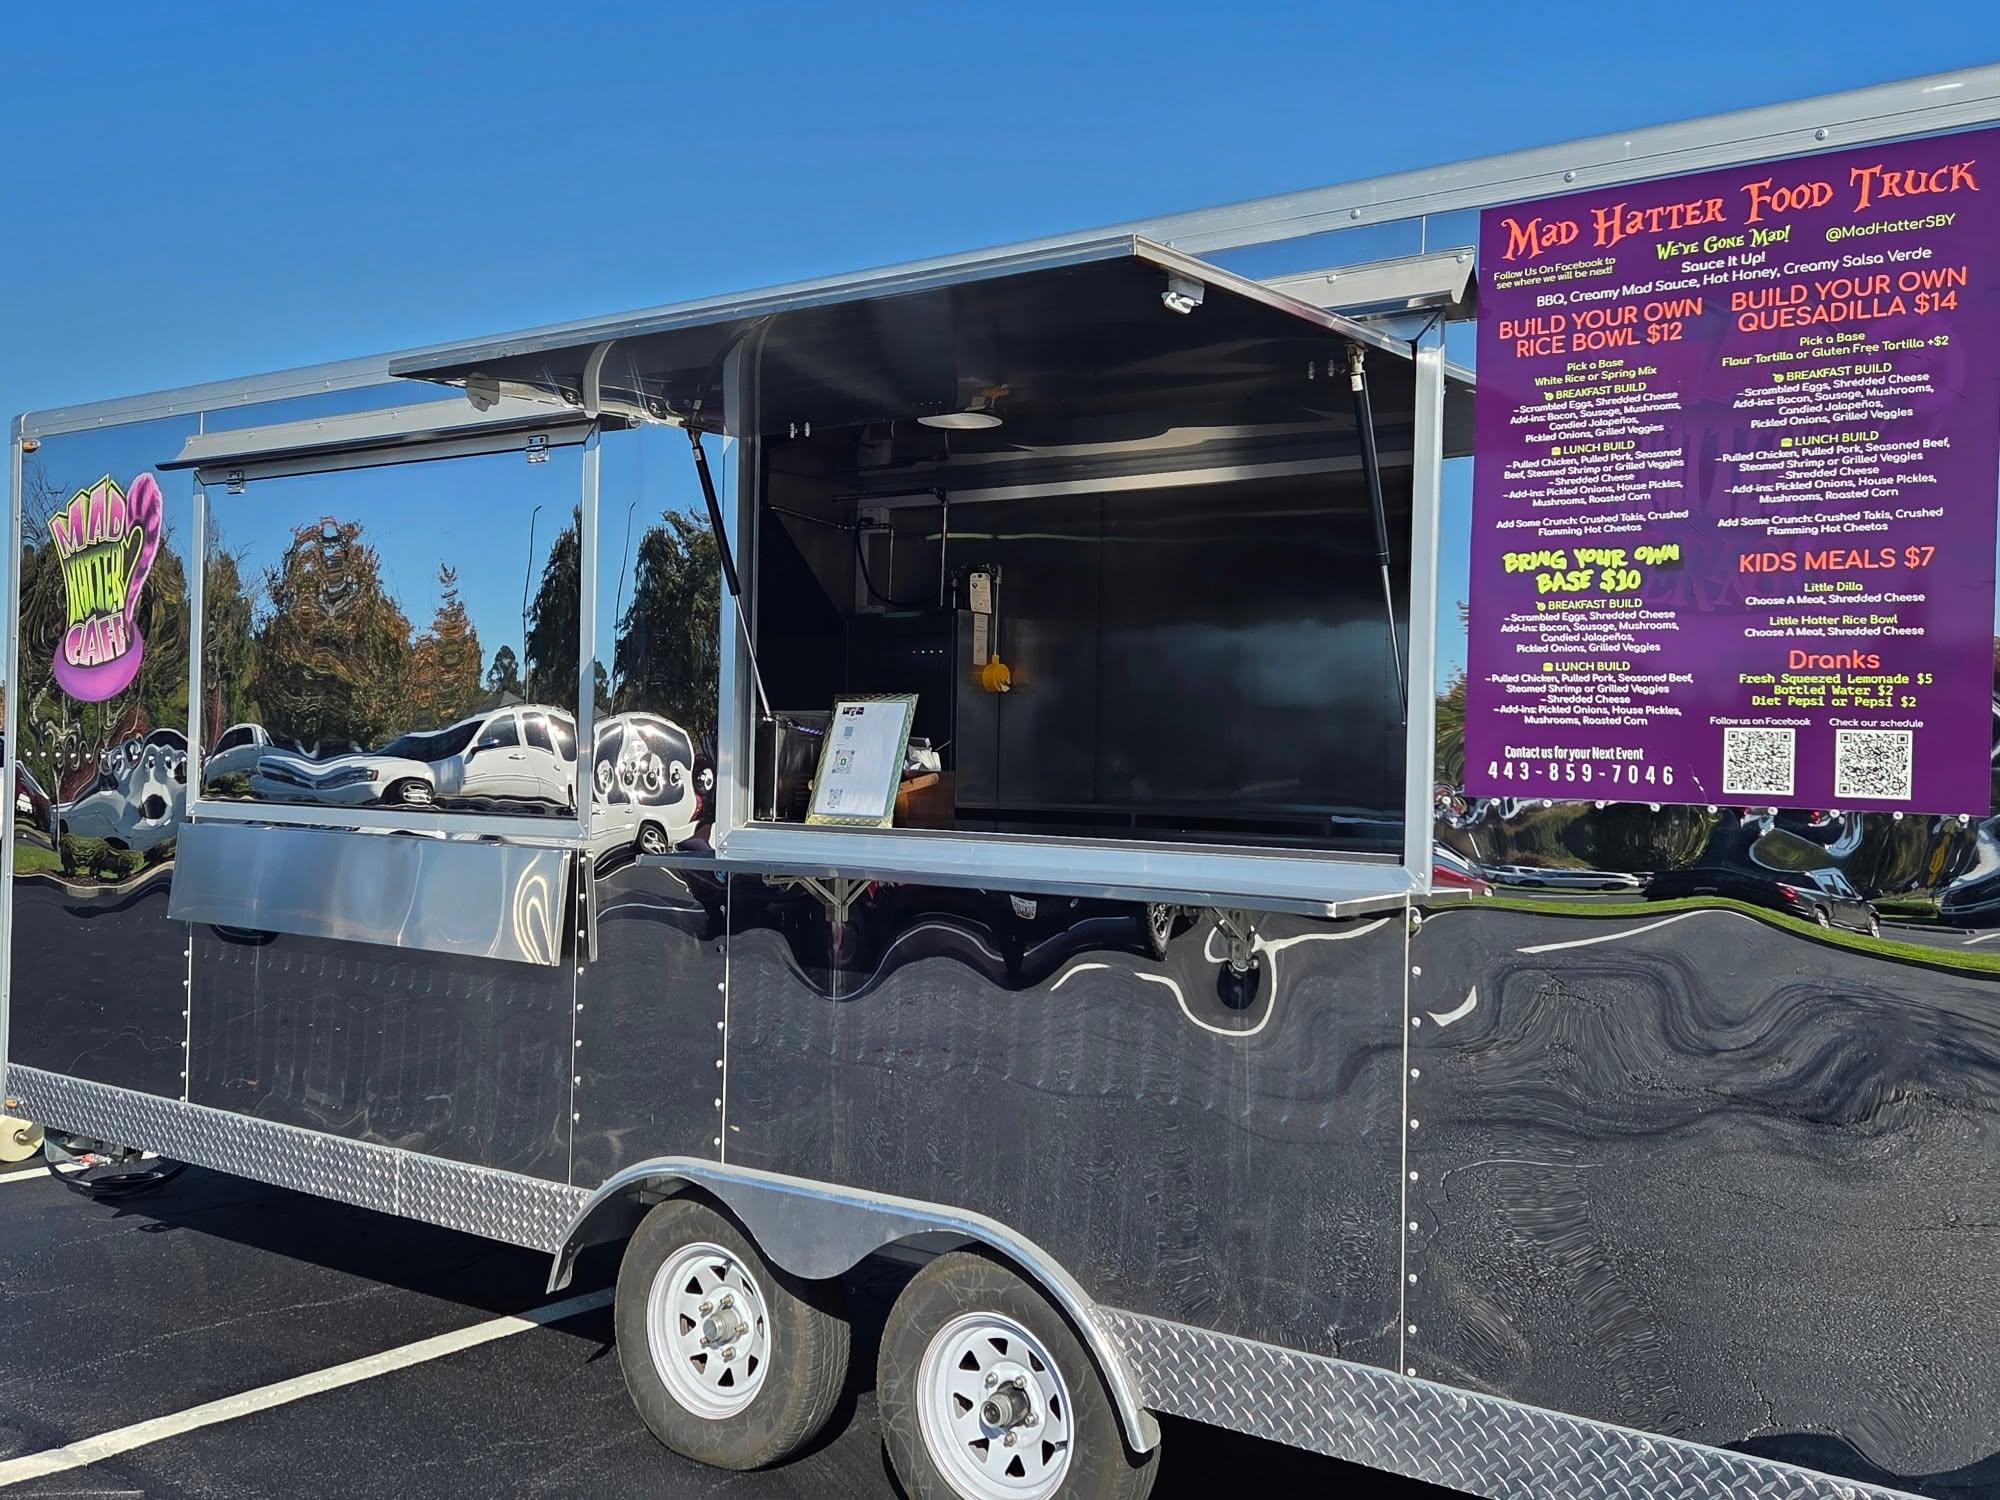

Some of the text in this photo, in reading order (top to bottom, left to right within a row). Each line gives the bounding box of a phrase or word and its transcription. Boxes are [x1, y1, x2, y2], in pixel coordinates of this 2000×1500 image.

[1826, 213, 1955, 242] @MadHatterSBY
[1494, 271, 1523, 280] Follow
[1525, 267, 1537, 276] Us
[1539, 265, 1553, 274] On
[1555, 258, 1603, 271] Facebook
[1681, 251, 1765, 272] Sauce It Up!
[1496, 281, 1512, 289] see
[1514, 277, 1541, 286] where
[1557, 271, 1572, 280] will
[1574, 270, 1587, 278] be
[1589, 265, 1612, 276] next!
[1570, 289, 1620, 302] Creamy
[1622, 281, 1652, 296] Mad
[1703, 272, 1729, 285] Hot
[1783, 259, 1839, 274] Creamy
[1842, 253, 1883, 267] Salsa
[1887, 247, 1932, 262] Verde
[1730, 265, 1967, 312] BUILD YOUR OWN
[1498, 296, 1703, 340] BUILD YOUR OWN
[1737, 289, 1958, 332] QUESADILLA $14
[1515, 320, 1683, 358] RICE BOWL $12
[1800, 335, 1822, 346] Pick
[1836, 333, 1865, 342] Base
[1722, 357, 1752, 366] Flour
[1754, 351, 1793, 363] Tortilla
[1796, 351, 1809, 359] or
[1811, 347, 1850, 357] Gluten
[1852, 343, 1879, 353] Free
[1882, 338, 1924, 350] Tortilla
[1567, 361, 1587, 371] Pick
[1598, 359, 1624, 368] Base
[1786, 362, 1891, 381] BREAKFAST BUILD
[1534, 376, 1563, 386] White
[1565, 374, 1585, 383] Rice
[1601, 369, 1636, 380] Spring
[1638, 366, 1656, 375] Mix
[1556, 382, 1646, 399] BREAKFAST BUILD
[1751, 417, 1787, 428] Pickled
[1832, 410, 1867, 421] Grilled
[1870, 408, 1913, 419] Veggies
[1778, 403, 1822, 415] Candied
[1563, 440, 1635, 454] LUNCH BUILD
[1795, 430, 1879, 445] LUNCH BUILD
[1739, 460, 1784, 471] Steamed
[1786, 459, 1825, 468] Shrimp
[1842, 454, 1877, 464] Grilled
[1879, 451, 1923, 463] Veggies
[1825, 488, 1869, 499] Roasted
[1871, 488, 1898, 497] Corn
[50, 480, 127, 560] MAD
[1717, 518, 1739, 527] Add
[1740, 517, 1769, 526] Some
[1814, 511, 1860, 522] Crushed
[1895, 507, 1943, 518] Crushed
[1820, 524, 1841, 532] Hot
[1843, 522, 1888, 532] Cheetos
[1502, 544, 1679, 572] BRING YOUR OWN
[1738, 544, 1935, 573] KIDS MEALS $7
[67, 543, 125, 628] HATTER
[1535, 568, 1641, 594] BASE $10
[1804, 581, 1863, 592] Little Dilla
[1548, 598, 1642, 610] BREAKFAST BUILD
[1745, 596, 1785, 605] Choose
[1786, 596, 1795, 604] A
[1828, 593, 1881, 603] Shredded
[1884, 593, 1925, 602] Cheese
[1769, 614, 1897, 625] Little Hatter Rice Bowl
[1516, 644, 1548, 652] Pickled
[1588, 641, 1620, 652] Grilled
[1622, 641, 1660, 653] Veggies
[1555, 661, 1630, 671] LUNCH BUILD
[1788, 648, 1881, 670] Dranks
[1739, 673, 1932, 685] Fresh Squeezed Lemonade $5
[1774, 684, 1893, 696] Bottled Water $2
[1752, 695, 1916, 708] Diet Pepsi or Pepsi $2
[1710, 716, 1738, 724] Follow
[1765, 717, 1810, 725] Facebook
[1829, 718, 1858, 726] Check
[1880, 719, 1923, 727] schedule
[1504, 745, 1643, 761] Contact us for your Next Event
